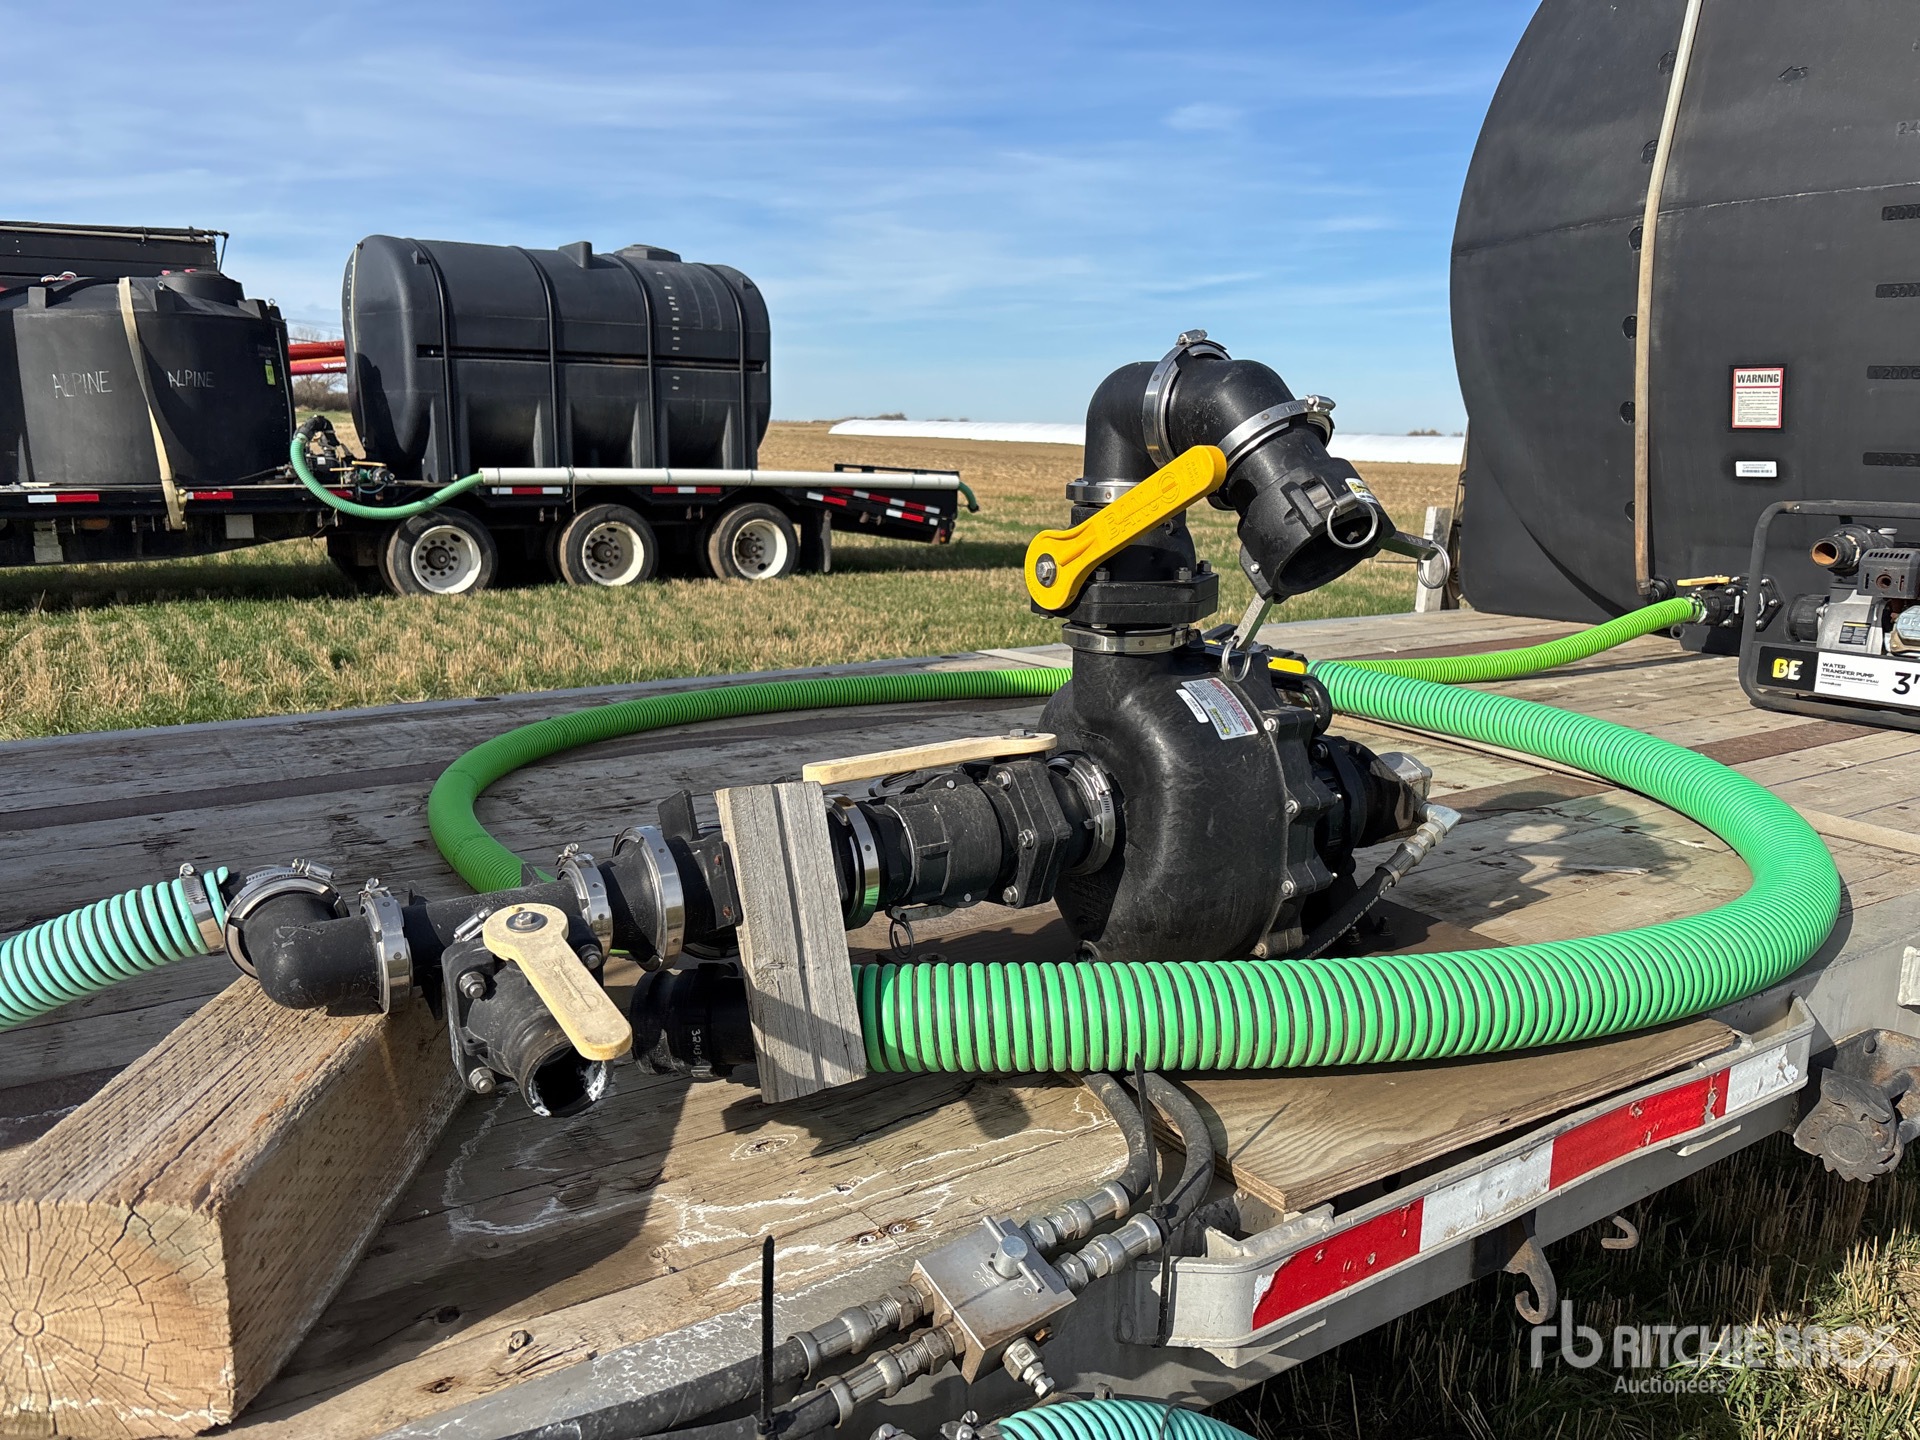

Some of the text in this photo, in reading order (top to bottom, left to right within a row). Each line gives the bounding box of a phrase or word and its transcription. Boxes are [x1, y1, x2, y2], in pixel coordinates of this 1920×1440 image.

[52, 370, 112, 398] ALPINE
[167, 369, 215, 388] ALPINE
[1737, 374, 1779, 383] WARNING
[1772, 658, 1803, 680] BE
[1822, 668, 1855, 676] TRANSFER
